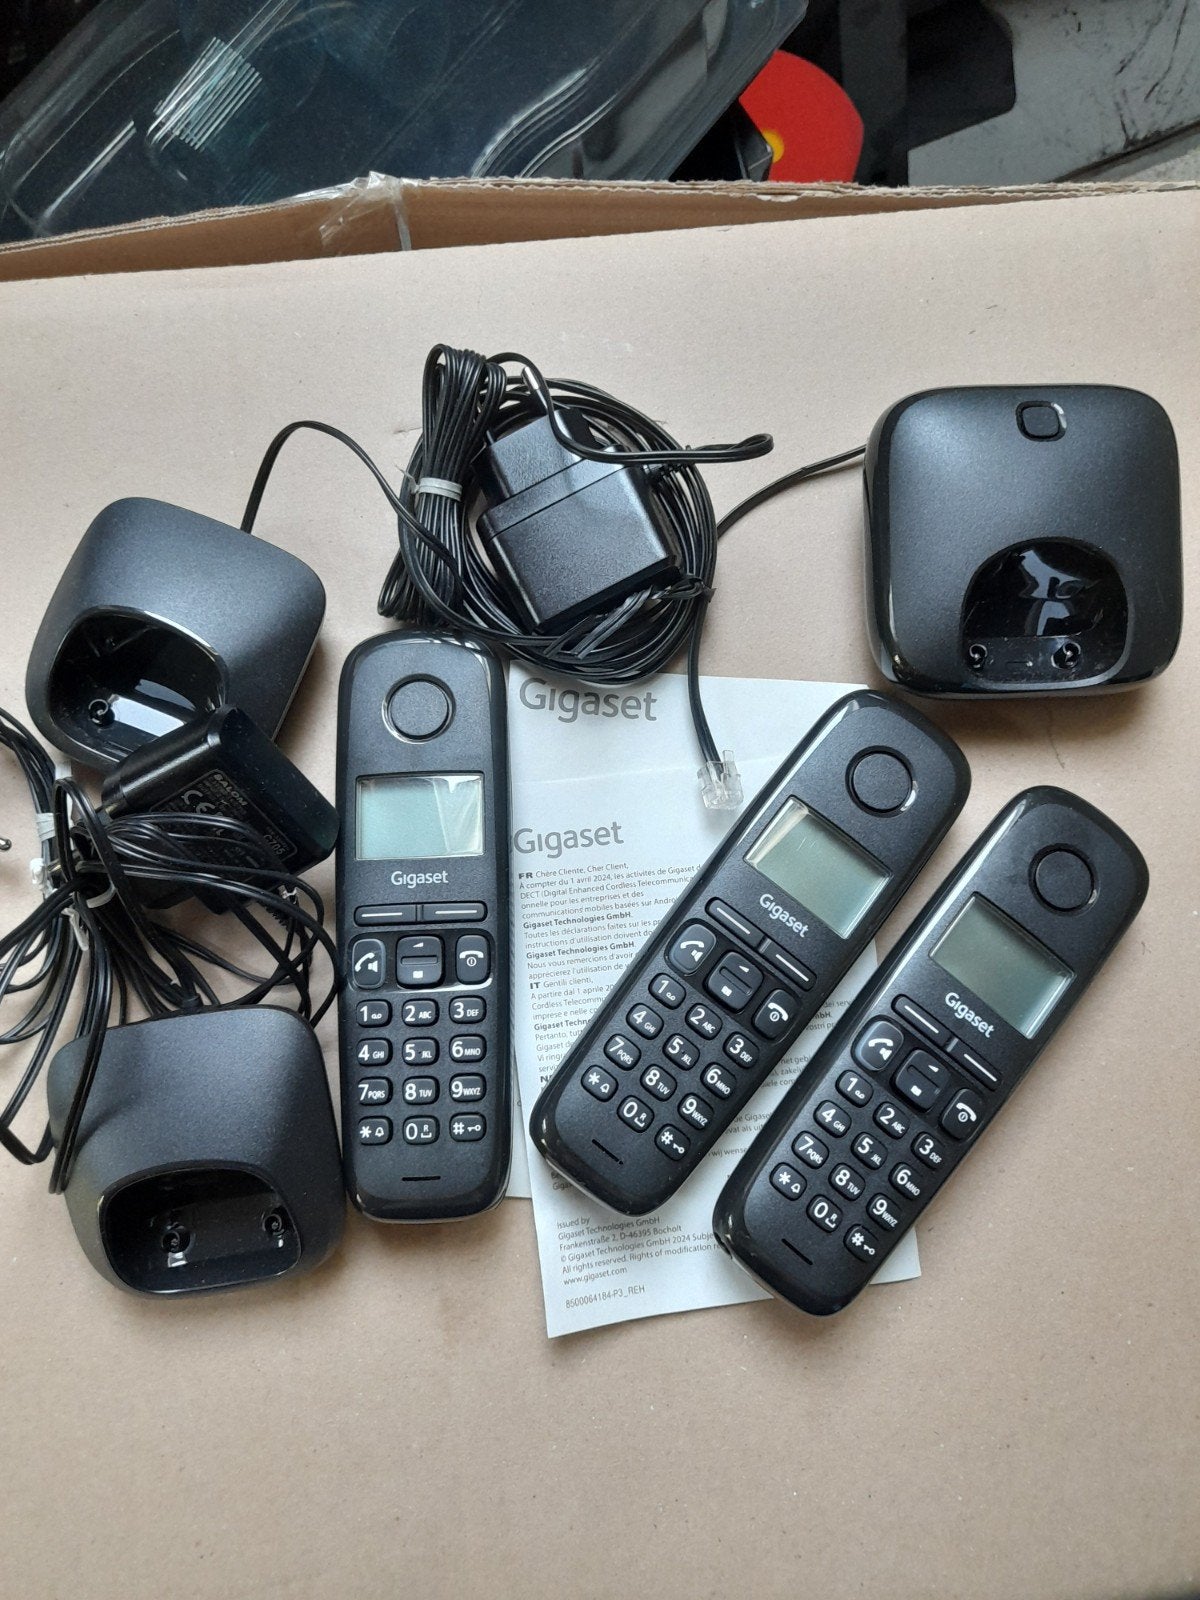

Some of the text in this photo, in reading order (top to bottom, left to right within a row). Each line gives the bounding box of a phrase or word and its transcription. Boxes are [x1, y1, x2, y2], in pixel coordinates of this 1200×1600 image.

[519, 678, 657, 723] Gigaset
[514, 822, 624, 858] Gigaset
[391, 871, 448, 888] Gigaset
[518, 872, 533, 880] FR
[525, 880, 556, 889] compter
[559, 878, 569, 886] du
[576, 875, 591, 884] avril
[657, 868, 666, 876] de
[668, 865, 695, 876] Gigaset
[520, 891, 540, 900] DECT
[569, 884, 605, 894] Enhanced
[606, 881, 637, 891] Cordless
[550, 899, 568, 908] pour
[580, 893, 621, 903] entreprises
[522, 907, 584, 919] communications
[585, 903, 614, 912] mobiles
[759, 894, 809, 937] Gigaset
[523, 919, 553, 930] Gigaset
[554, 914, 605, 926] Technologies
[524, 930, 548, 939] Toutes
[607, 922, 627, 930] faites
[641, 919, 650, 927] les
[526, 939, 568, 949] instructions
[614, 930, 642, 940] doivent
[526, 949, 556, 960] Gigaset
[557, 944, 608, 956] Technologies
[567, 955, 608, 965] remercions
[530, 981, 541, 989] IT
[538, 990, 562, 1001] partire
[563, 987, 575, 996] dal
[583, 984, 604, 995] aprile
[658, 980, 669, 993] 1
[360, 1006, 368, 1021] 1
[454, 1002, 464, 1018] 3
[532, 1001, 562, 1010] Cordless
[405, 1006, 415, 1022] 2
[633, 1010, 646, 1024] 4
[690, 1008, 716, 1033] 2 ABC
[945, 992, 994, 1038] Gigaset
[534, 1020, 564, 1032] Gigaset
[358, 1045, 369, 1060] 4
[405, 1044, 415, 1060] 5
[452, 1041, 463, 1057] 6
[536, 1041, 564, 1052] Gigaset
[609, 1038, 633, 1064] 7 PQRS
[668, 1038, 683, 1053] 5
[729, 1039, 752, 1062] 3 DEF
[452, 1081, 462, 1098] 9
[645, 1070, 670, 1094] 8 TUV
[706, 1069, 730, 1094] 6 MNO
[847, 1078, 858, 1091] 1
[358, 1084, 385, 1100] 7 PQRS
[405, 1084, 432, 1100] 8 TUV
[623, 1102, 637, 1117] 0
[682, 1099, 697, 1114] 9
[822, 1108, 836, 1122] 4
[879, 1108, 905, 1134] 2 ABC
[406, 1123, 418, 1139] 0
[799, 1136, 823, 1164] 7 PQRS
[858, 1138, 873, 1153] 5
[919, 1139, 942, 1164] 3 DEF
[835, 1170, 860, 1195] 8 TUV
[896, 1170, 920, 1196] 6 MNO
[814, 1202, 828, 1218] 0
[873, 1200, 888, 1215] 9
[557, 1216, 591, 1229] Issued by
[558, 1215, 660, 1241] Gigaset Technologies GmbH
[620, 1228, 651, 1241] D-46395
[653, 1223, 682, 1236] Bocholt
[568, 1249, 596, 1262] Gigaset
[596, 1243, 645, 1256] Technologies
[646, 1237, 671, 1248] GmbH
[672, 1234, 691, 1245] 2024
[562, 1264, 571, 1274] All
[572, 1261, 594, 1273] rights
[629, 1252, 654, 1262] Rights
[654, 1250, 663, 1258] of
[664, 1244, 712, 1256] modification
[563, 1266, 628, 1285] www.gigaset.com
